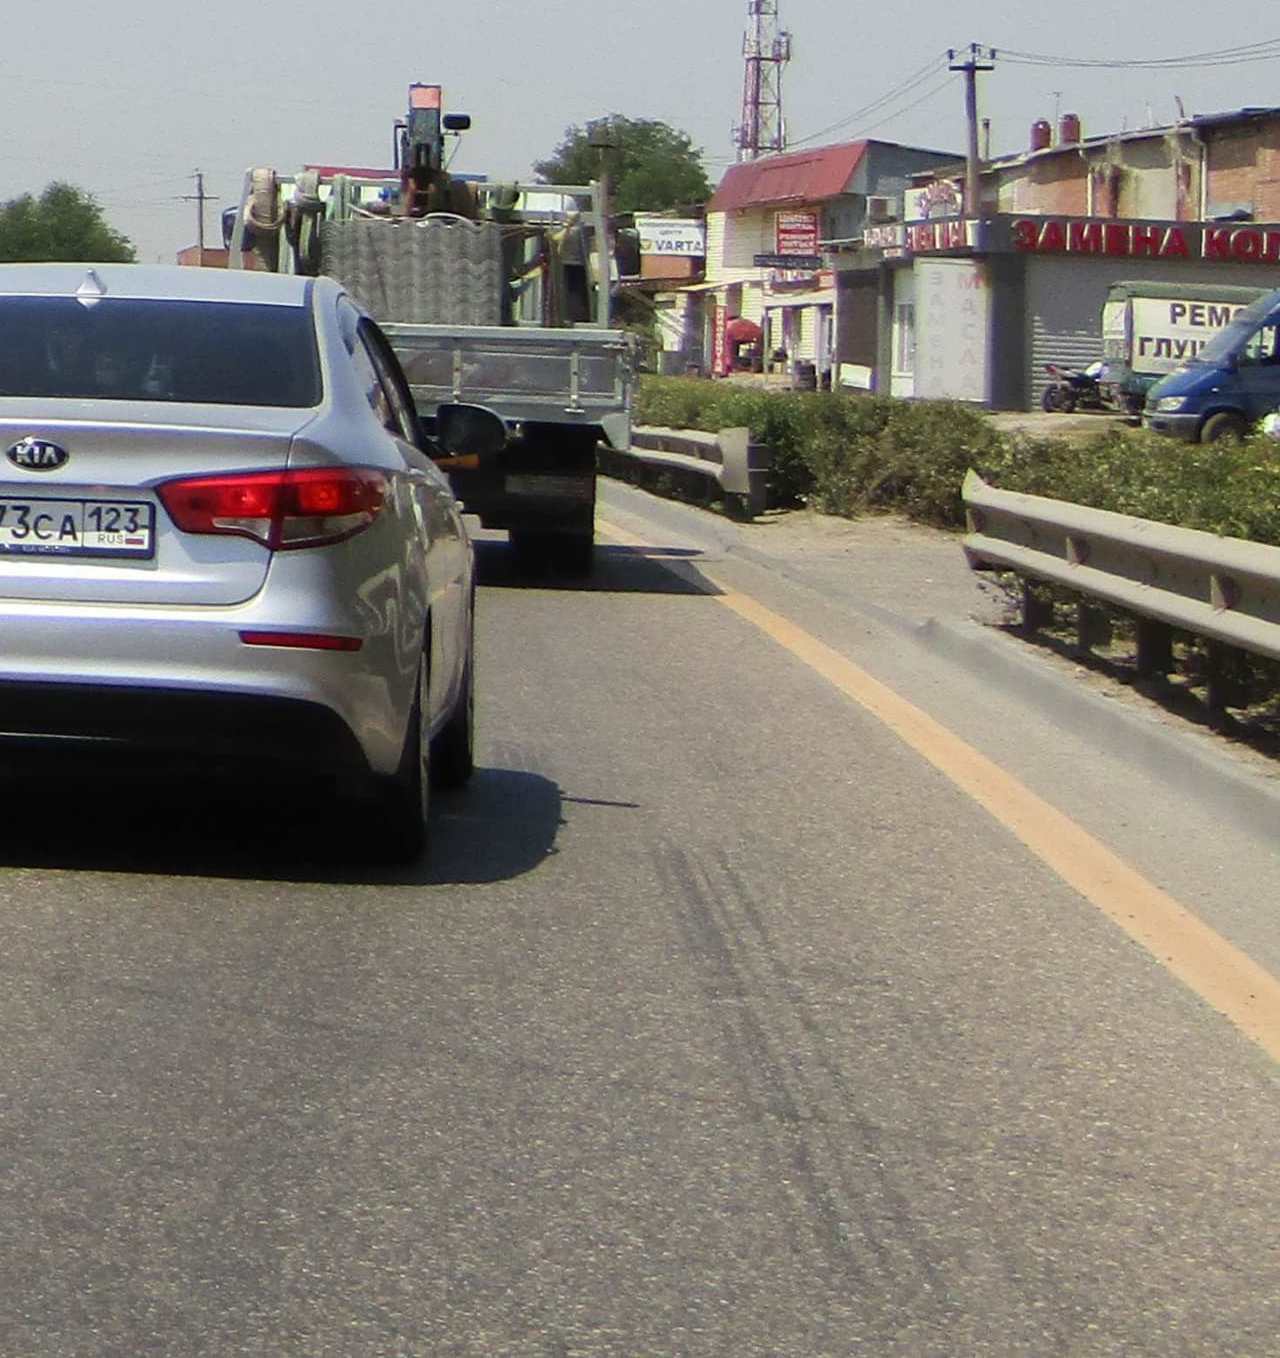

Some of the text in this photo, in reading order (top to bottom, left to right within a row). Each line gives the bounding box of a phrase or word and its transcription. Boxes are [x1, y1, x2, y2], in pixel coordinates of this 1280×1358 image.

[656, 240, 704, 251] VARTA
[1010, 219, 1189, 256] ЗАМЕНА
[16, 445, 58, 464] KIA
[88, 507, 140, 534] 123
[98, 534, 124, 544] RUS
